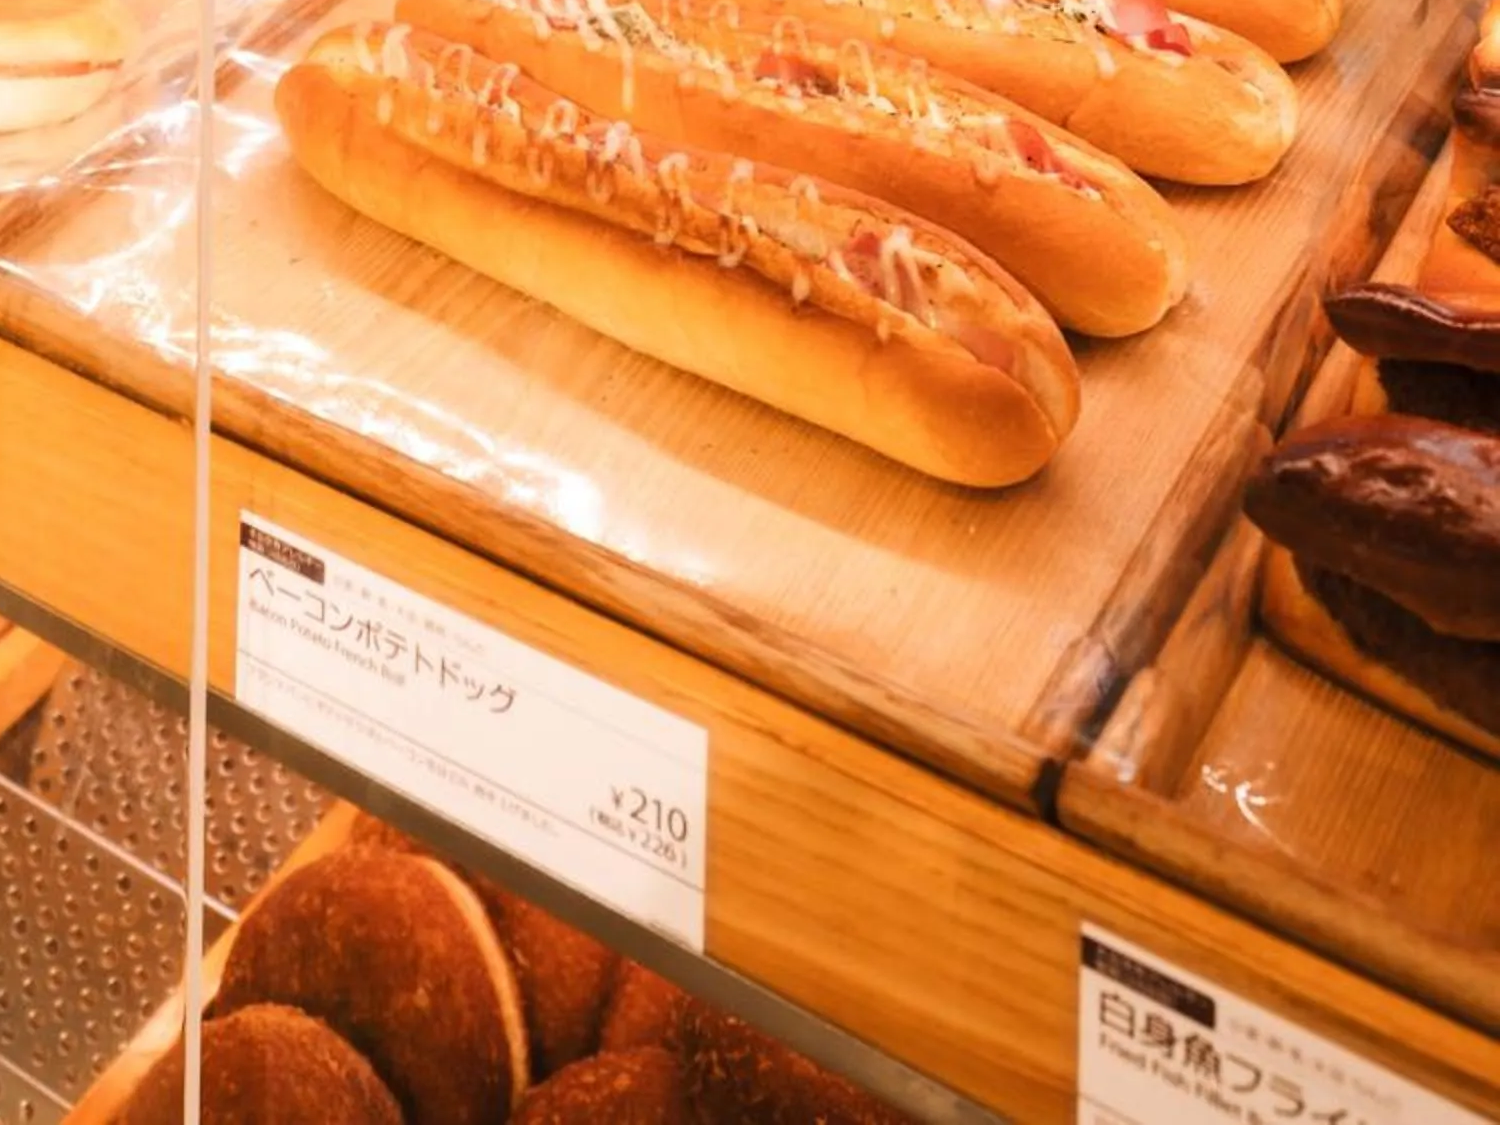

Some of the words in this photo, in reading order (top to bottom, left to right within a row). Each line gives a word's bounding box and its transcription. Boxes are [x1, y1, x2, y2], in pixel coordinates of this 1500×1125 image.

[248, 567, 518, 714] ベーコンポテトドッグ
[609, 782, 690, 844] ¥210
[1099, 1032, 1148, 1072] Fried
